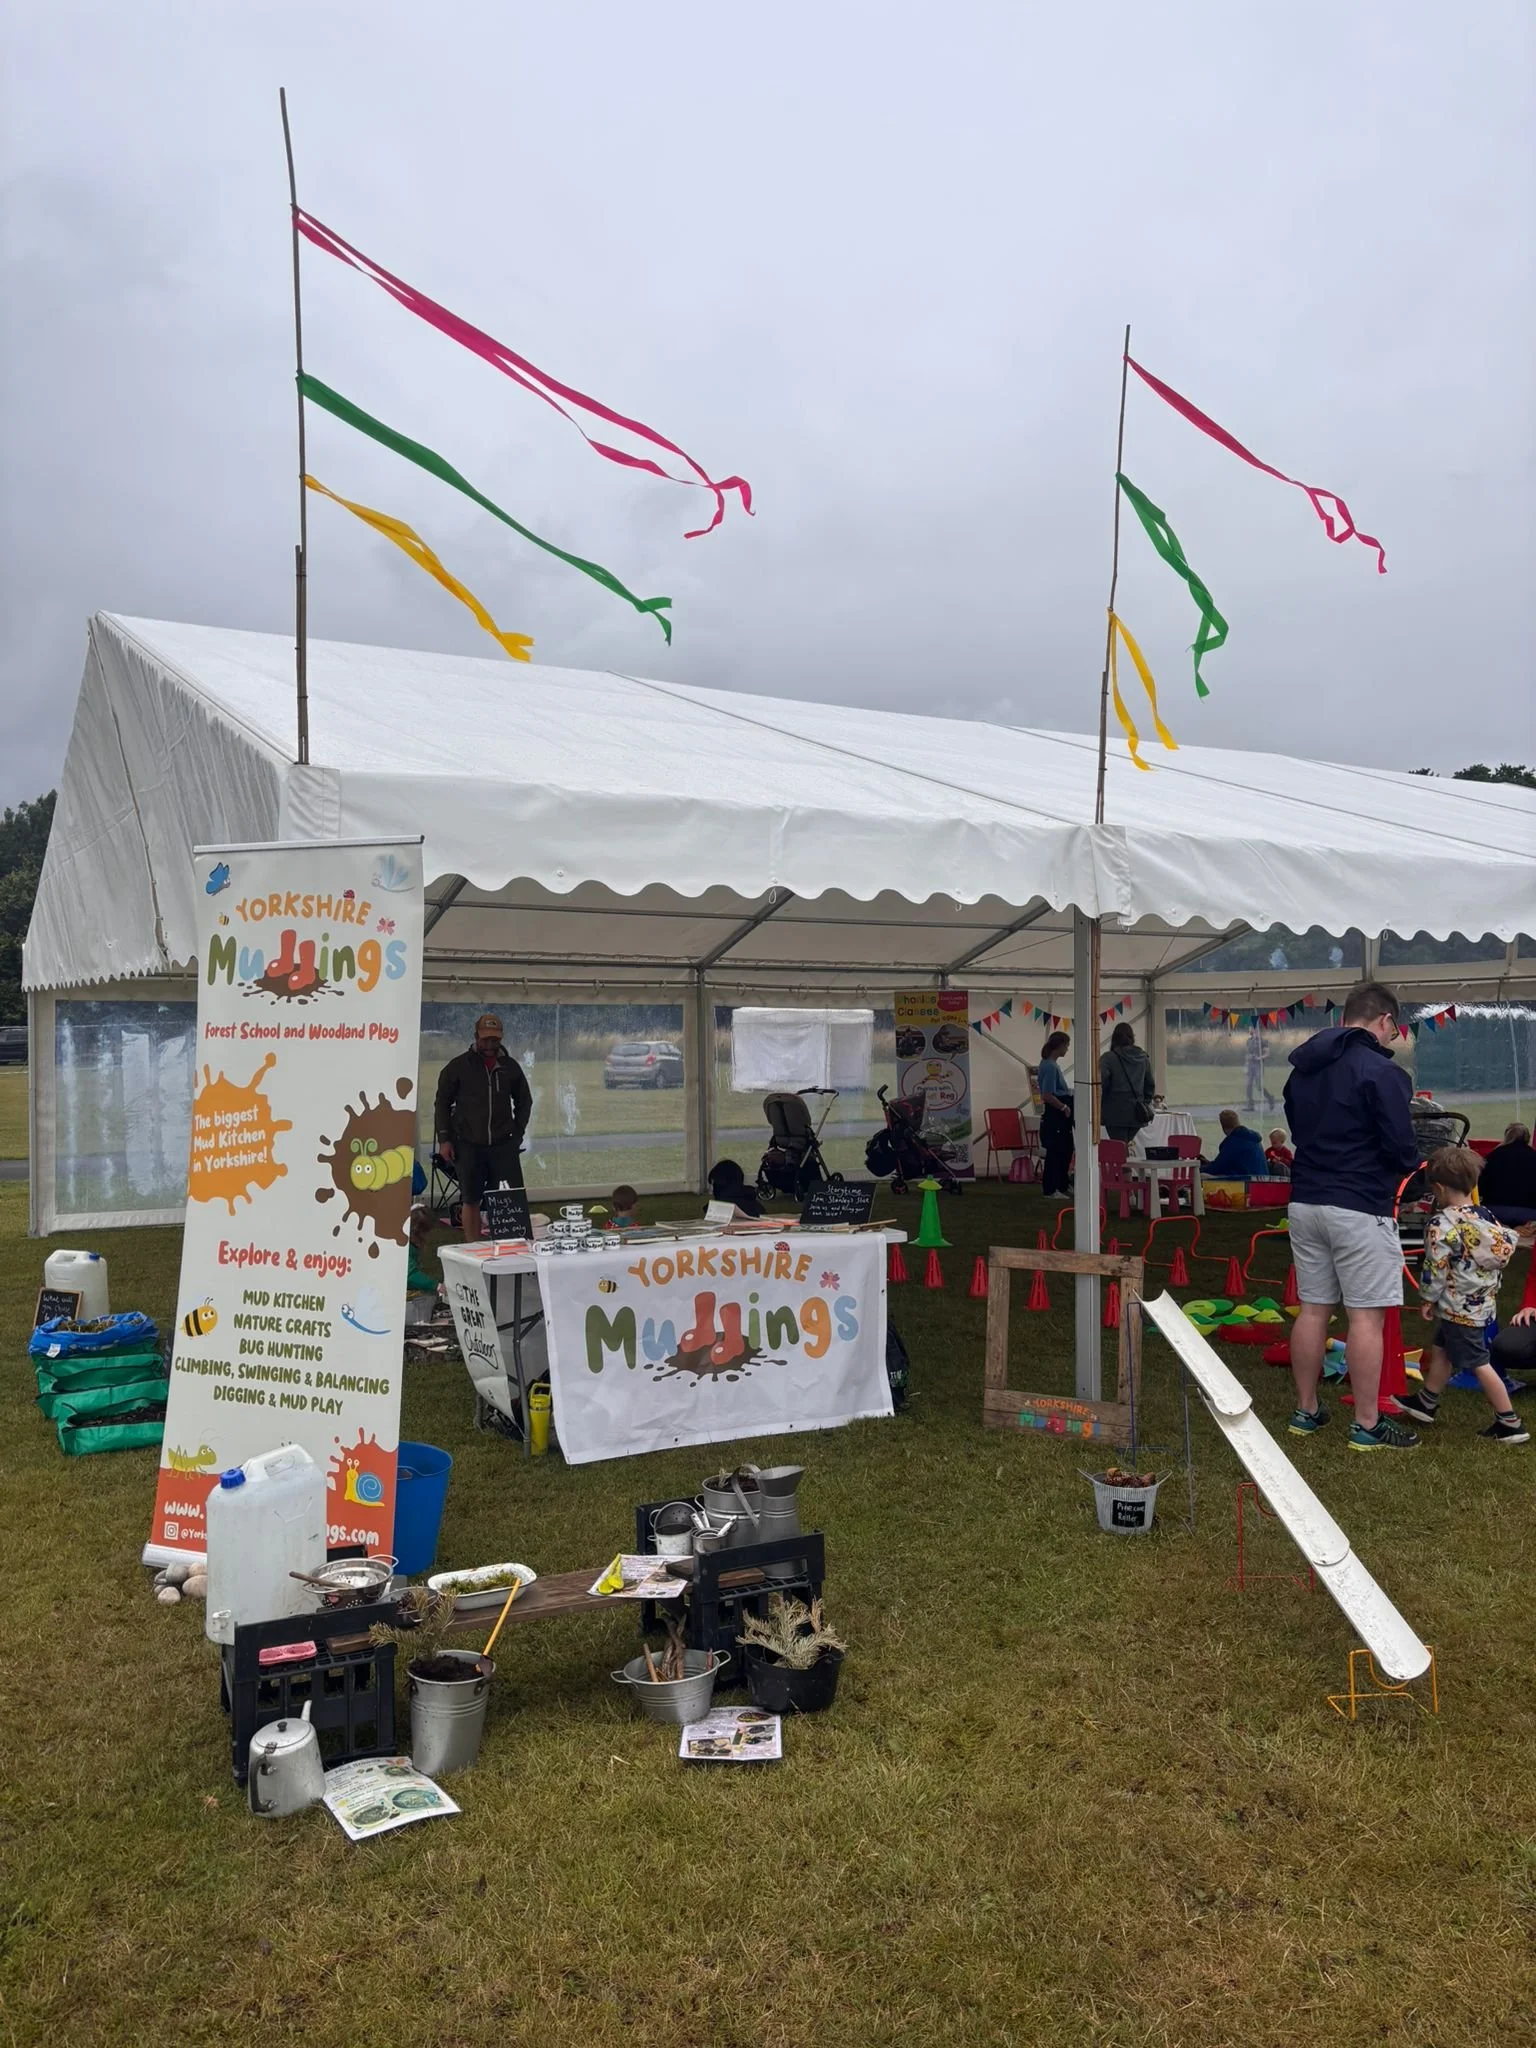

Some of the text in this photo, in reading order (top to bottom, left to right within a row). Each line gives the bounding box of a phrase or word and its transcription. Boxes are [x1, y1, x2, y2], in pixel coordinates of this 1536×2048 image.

[235, 890, 372, 925] YORKSHIRE
[240, 1021, 280, 1040] School
[284, 1023, 305, 1040] and
[309, 1022, 365, 1041] Woodland
[368, 1022, 399, 1044] Play
[194, 1104, 259, 1131] The biggest
[194, 1128, 266, 1153] Mud Kitchen
[193, 1146, 268, 1173] in Yorkshire!
[487, 1196, 513, 1208] Mugs
[512, 1224, 527, 1237] only
[218, 1240, 352, 1278] Explore & enjoy:
[628, 1246, 813, 1288] YORKSHIRE
[242, 1289, 325, 1312] MUD KITCHEN
[462, 1284, 480, 1307] THE
[233, 1313, 332, 1338] NATURE CRAFTS
[461, 1306, 486, 1329] GREAT
[239, 1338, 323, 1362] BUG HUNTING
[175, 1356, 390, 1396] CLIMBING, SWINGING & BALANCING
[213, 1384, 344, 1416] DIGGING & MUD PLAY
[1032, 1398, 1090, 1415] YORKSHIRE
[164, 1500, 205, 1520] www.
